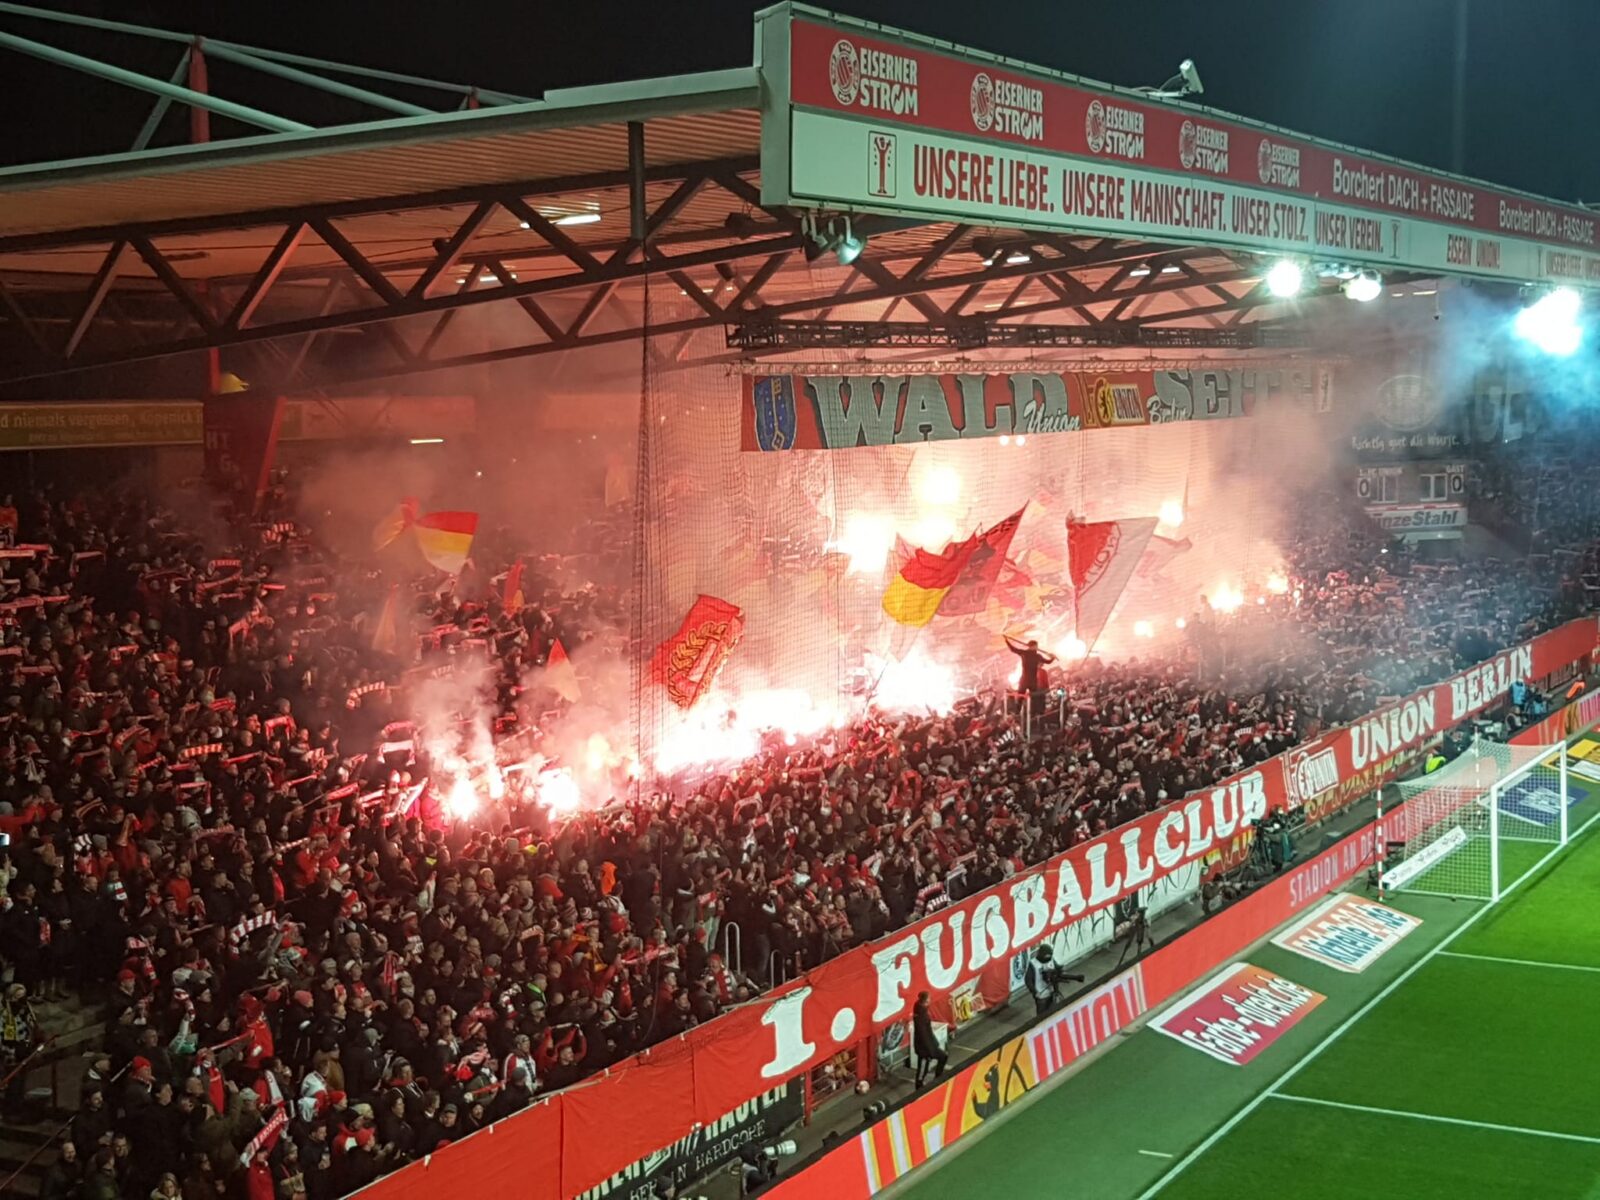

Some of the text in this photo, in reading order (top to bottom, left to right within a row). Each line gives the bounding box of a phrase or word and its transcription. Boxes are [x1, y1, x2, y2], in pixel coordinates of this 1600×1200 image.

[860, 47, 917, 86] EISERNER
[860, 77, 918, 116] STROM
[995, 79, 1043, 111] EISERNER
[995, 105, 1043, 140] STROM
[1106, 105, 1144, 133] EISERNER
[1196, 124, 1229, 152] EISERNER
[1105, 130, 1144, 159] STROM
[1196, 145, 1229, 174] STROM
[913, 143, 1384, 253] UNSERE LIEBE. UNSERE MANNSCHAFT. UNSER STOLZ. UNSER VEREIN.
[1332, 158, 1475, 221] Borchert DACH + FASSADE
[1499, 199, 1534, 233] Borchert
[1536, 209, 1557, 237] DACH
[1563, 215, 1594, 245] FASSADE
[808, 371, 1068, 448] WALD
[1023, 400, 1081, 433] Union
[1112, 387, 1144, 421] UNION
[1359, 478, 1370, 497] 0
[1452, 475, 1462, 492] 0
[1451, 644, 1532, 721] BERLIN
[1350, 690, 1436, 770] UNION
[1290, 853, 1340, 908] STADION
[1343, 840, 1357, 872] AN
[1295, 902, 1408, 965] kfzteile24.de
[760, 986, 856, 1079] 1.
[1181, 973, 1313, 1059] Farbe-direkt.de
[695, 1118, 766, 1171] HARDCORE
